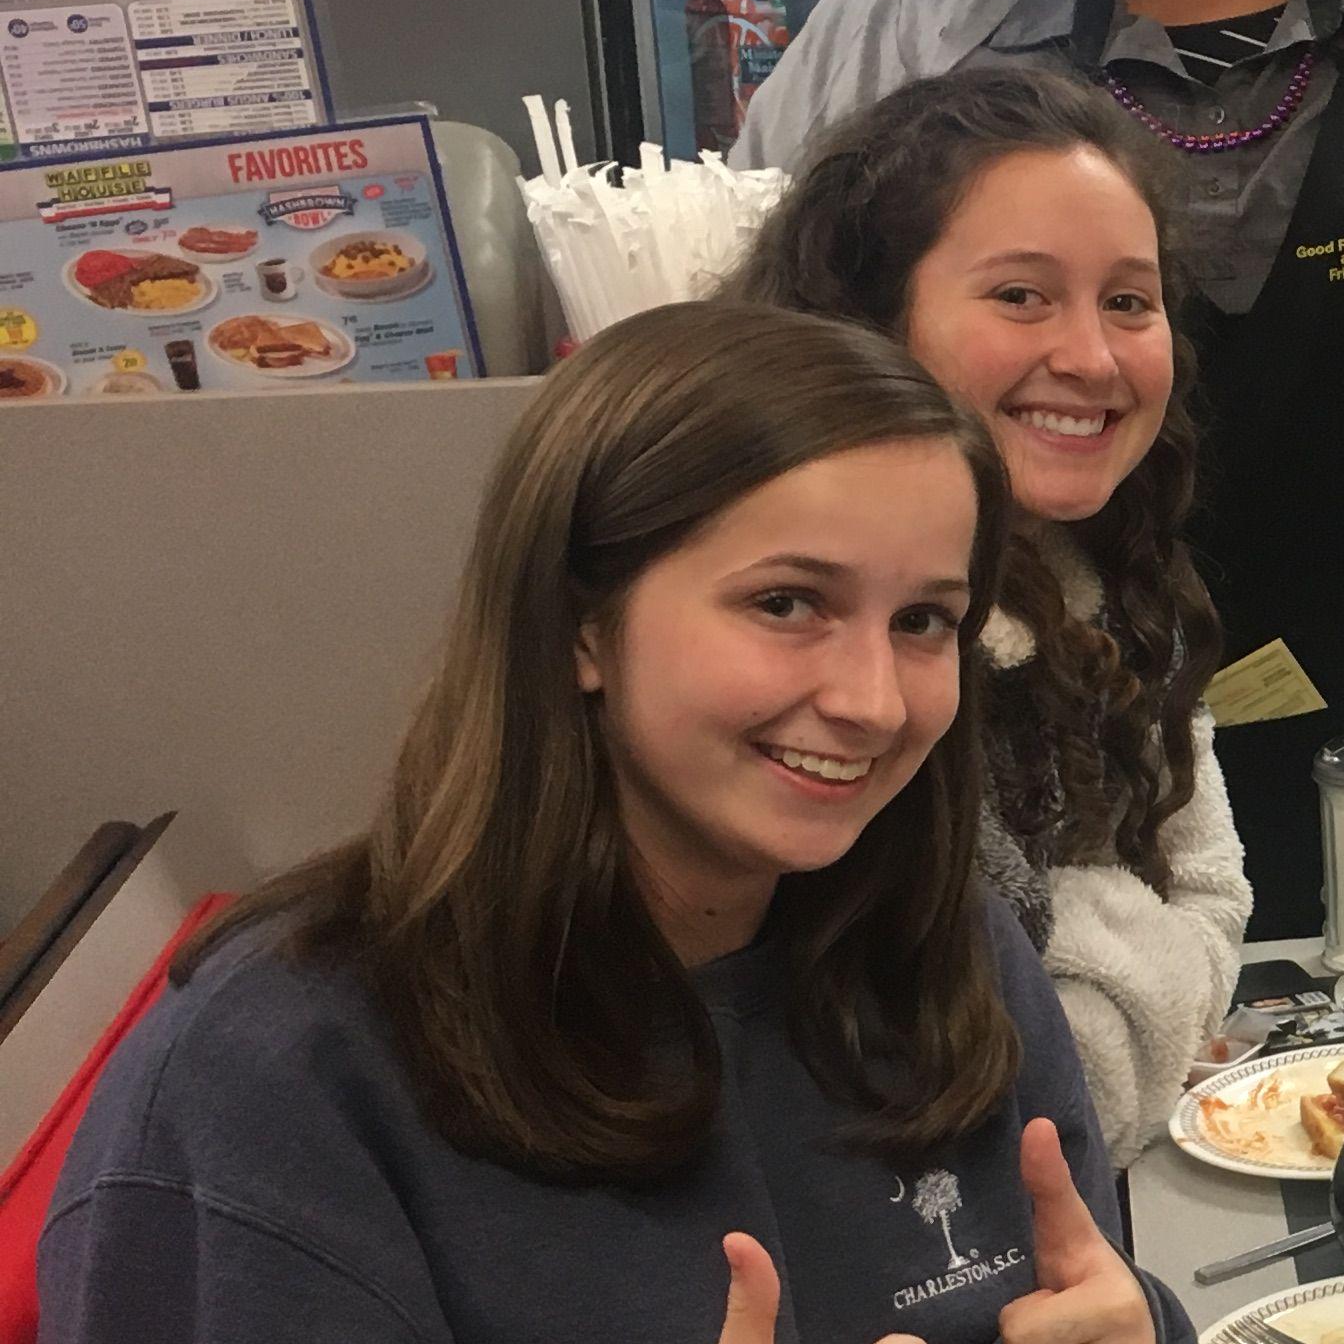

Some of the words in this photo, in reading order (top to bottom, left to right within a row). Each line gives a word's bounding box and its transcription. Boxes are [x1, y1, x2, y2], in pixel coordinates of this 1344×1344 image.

[217, 49, 298, 65] SANDWICHES
[29, 136, 143, 156] HASHBROWNS
[227, 139, 368, 183] FAVORITES
[47, 161, 149, 185] WAFFLE
[61, 179, 145, 200] HOUSE
[269, 197, 345, 215] HASHBROWN
[294, 210, 327, 226] BOWL
[1296, 241, 1335, 258] Good
